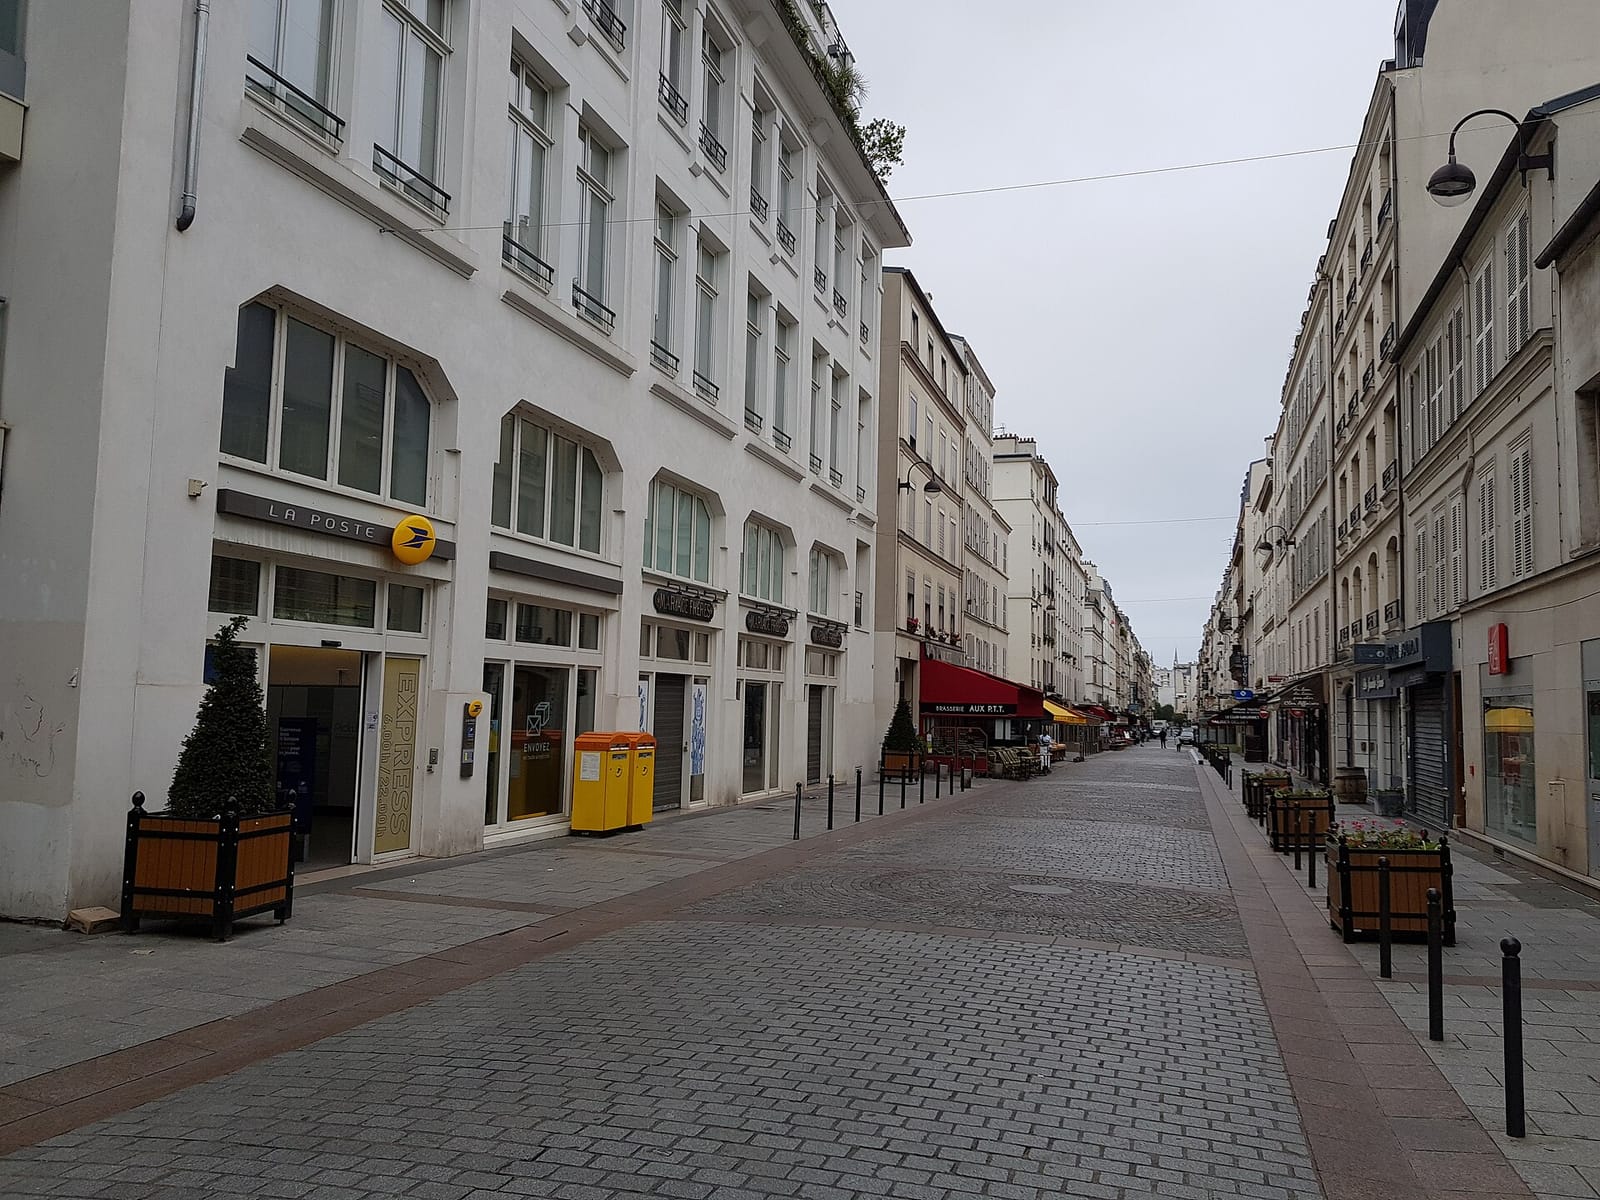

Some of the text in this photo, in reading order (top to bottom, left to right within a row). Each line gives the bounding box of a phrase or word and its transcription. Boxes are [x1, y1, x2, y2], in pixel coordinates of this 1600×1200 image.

[268, 504, 375, 538] LA POSTE
[969, 705, 985, 713] AUX
[389, 672, 417, 836] EXPRESS
[523, 742, 550, 753] ENVOYEZ
